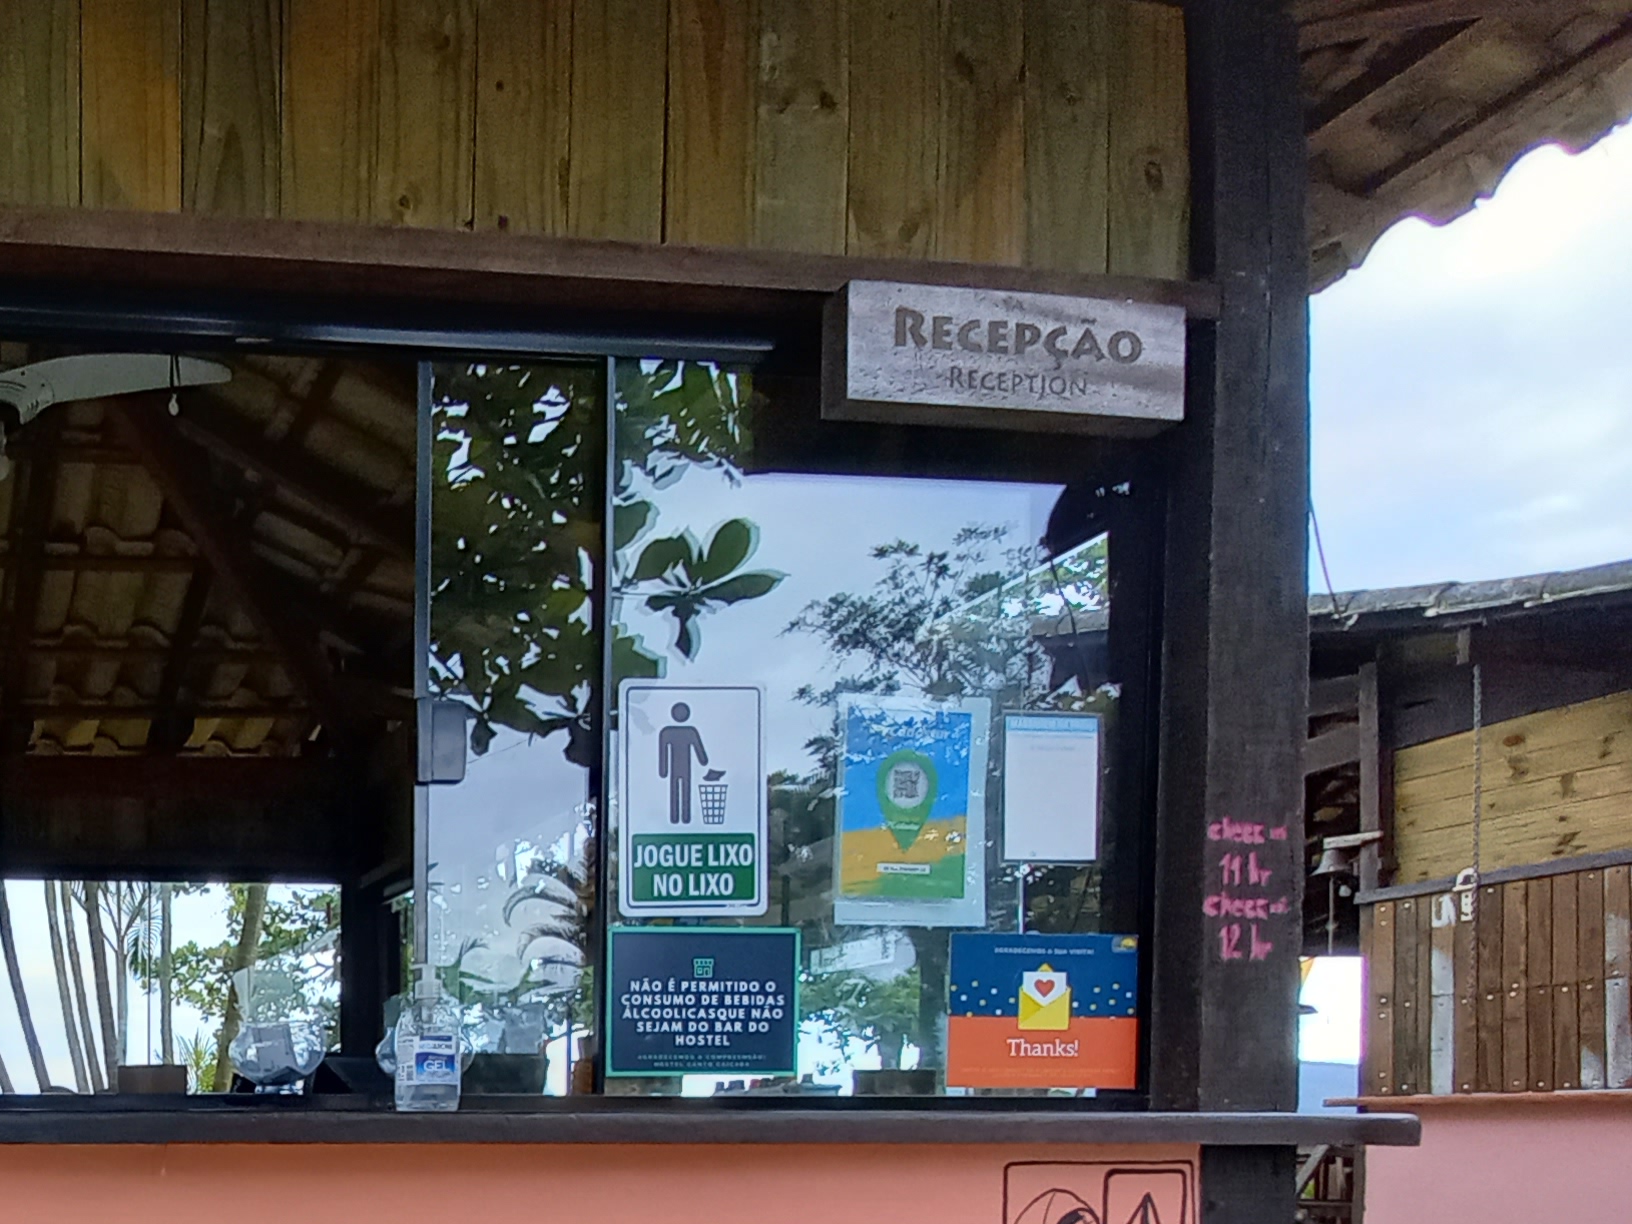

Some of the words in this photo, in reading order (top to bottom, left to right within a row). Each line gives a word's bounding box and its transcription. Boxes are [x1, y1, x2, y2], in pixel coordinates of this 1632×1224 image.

[894, 306, 1143, 370] RECEPÇÃO
[949, 366, 1087, 398] RECEPTION
[633, 844, 704, 868] JOGUE
[708, 843, 753, 866] LIXO
[653, 873, 683, 896] NO
[688, 873, 734, 896] LIXO
[1219, 923, 1242, 961] 12
[630, 977, 662, 992] NÃO
[668, 977, 675, 992] É
[681, 981, 760, 992] PERMITIDO
[765, 981, 776, 992] O
[621, 995, 696, 1006] CONSUMO
[701, 995, 718, 1005] DE
[724, 994, 785, 1006] BEBIDAS
[751, 1006, 784, 1019] NÃO
[636, 1021, 683, 1033] SEJAM
[688, 1021, 709, 1032] DO
[715, 1021, 743, 1032] BAR
[748, 1021, 769, 1033] DO
[675, 1035, 730, 1046] HOSTEL
[1006, 1037, 1079, 1057] Thanks!
[424, 1060, 450, 1071] GEL
